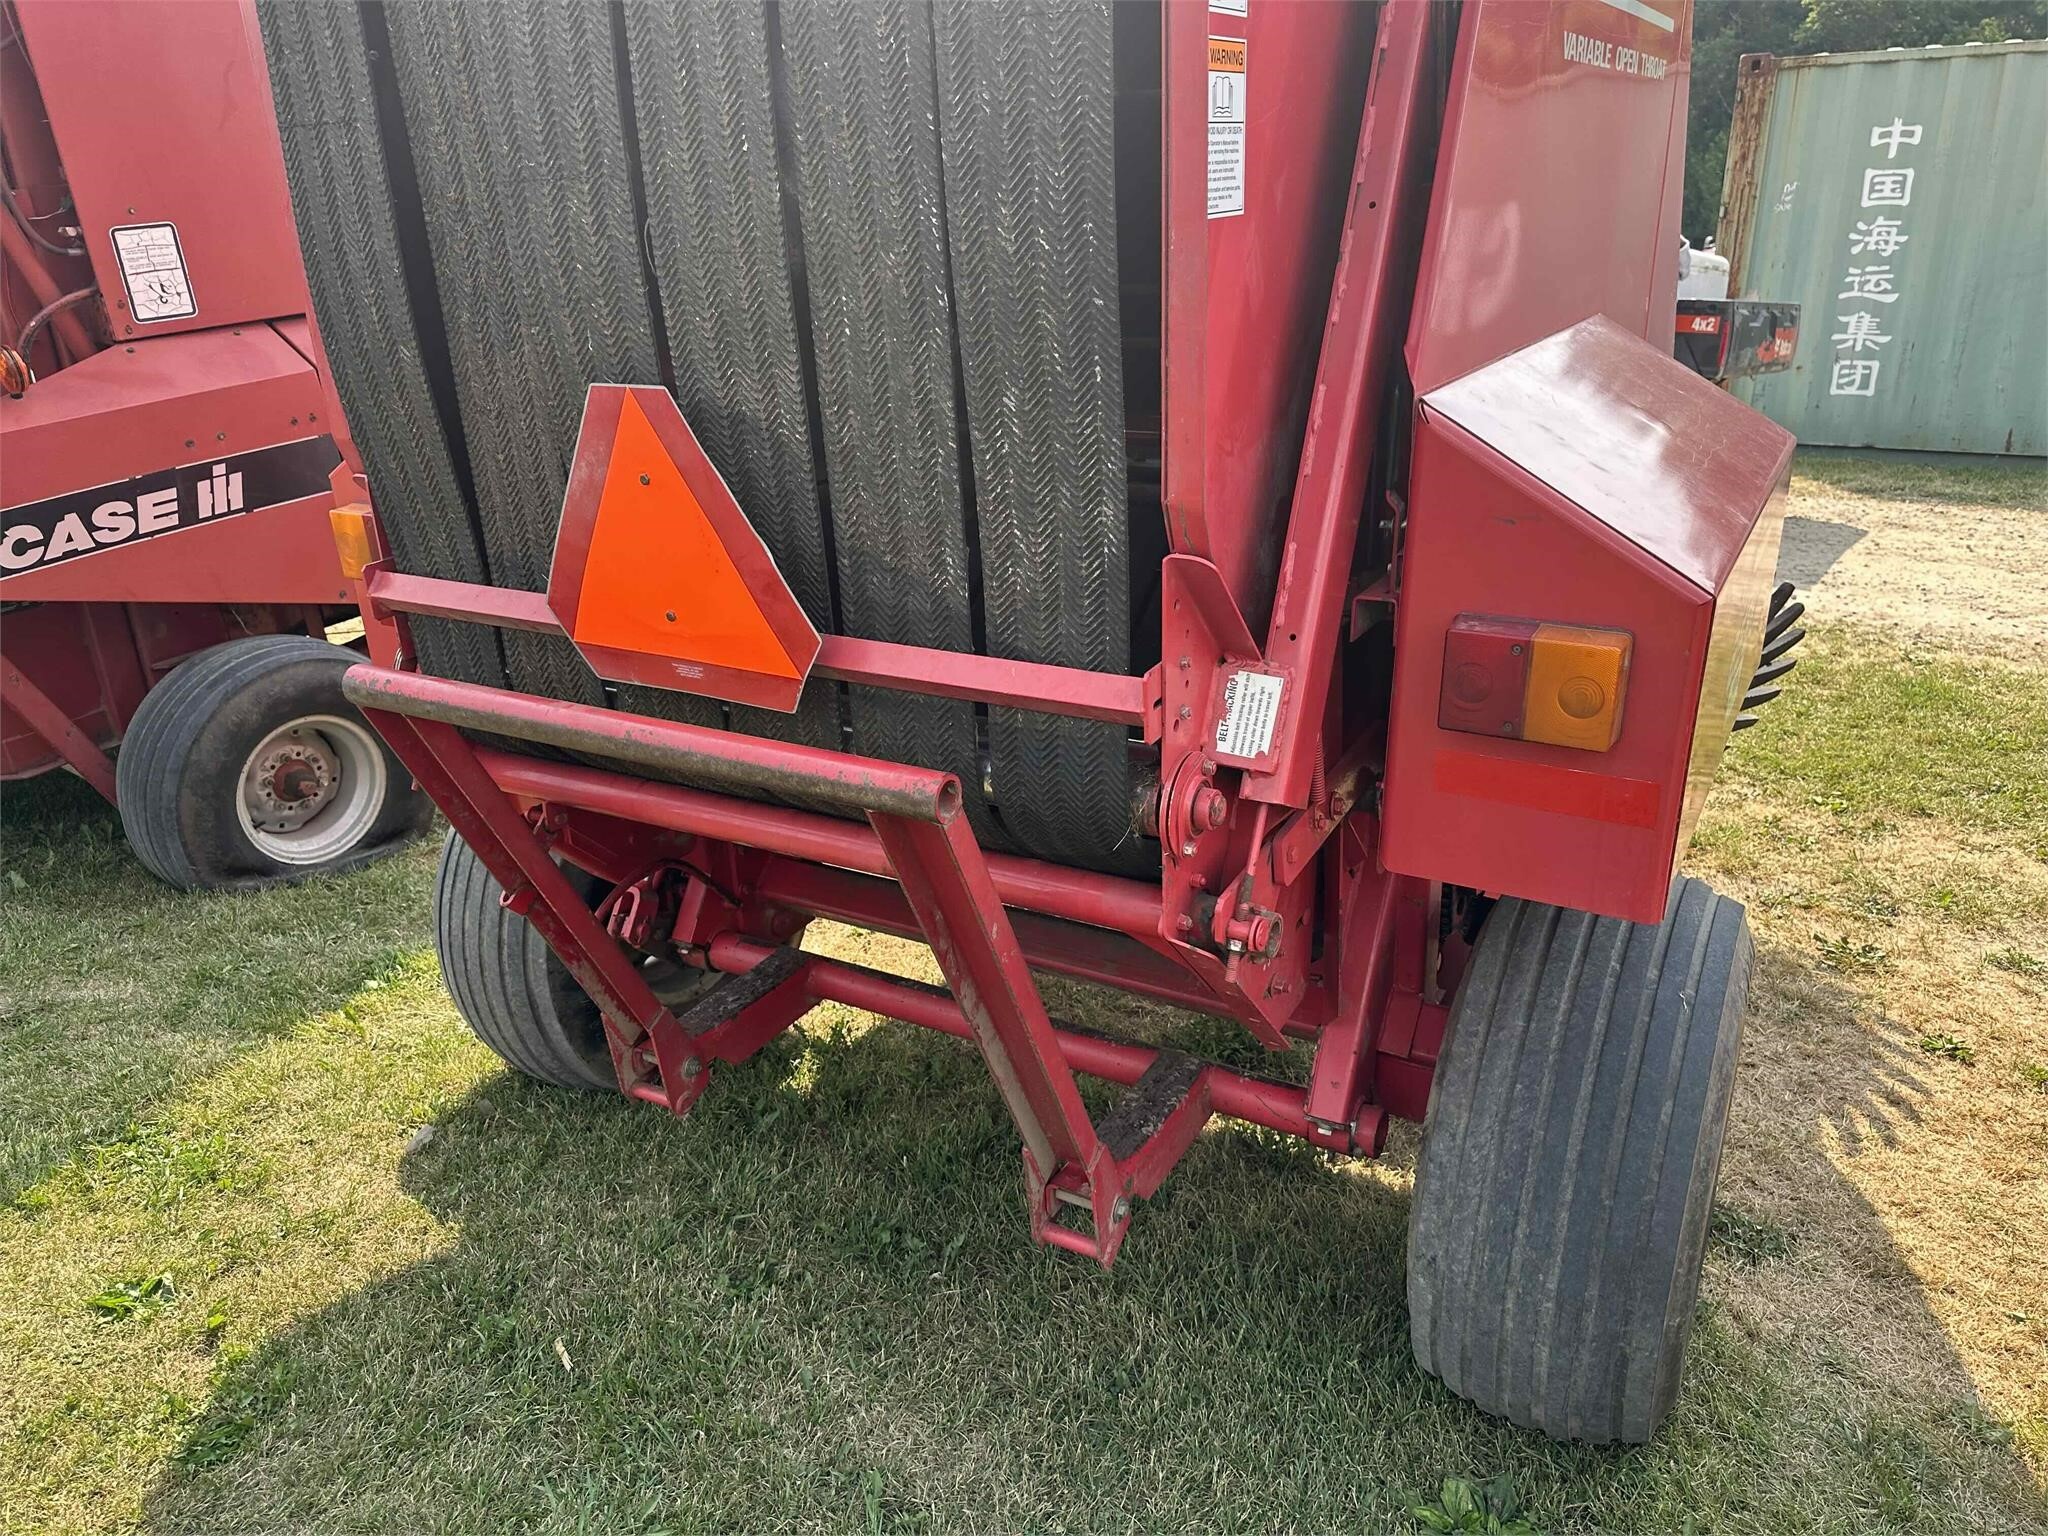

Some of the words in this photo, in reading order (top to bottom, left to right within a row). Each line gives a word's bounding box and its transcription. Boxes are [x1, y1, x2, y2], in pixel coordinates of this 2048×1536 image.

[1210, 48, 1244, 66] WARNING
[1563, 30, 1612, 69] VARIABLE
[1615, 46, 1639, 75] OPEN
[1641, 52, 1667, 81] THROAT
[1830, 117, 1922, 396] 中国海运集团
[1691, 317, 1716, 331] 4x2
[0, 487, 179, 569] CASE
[1218, 722, 1229, 742] BELT
